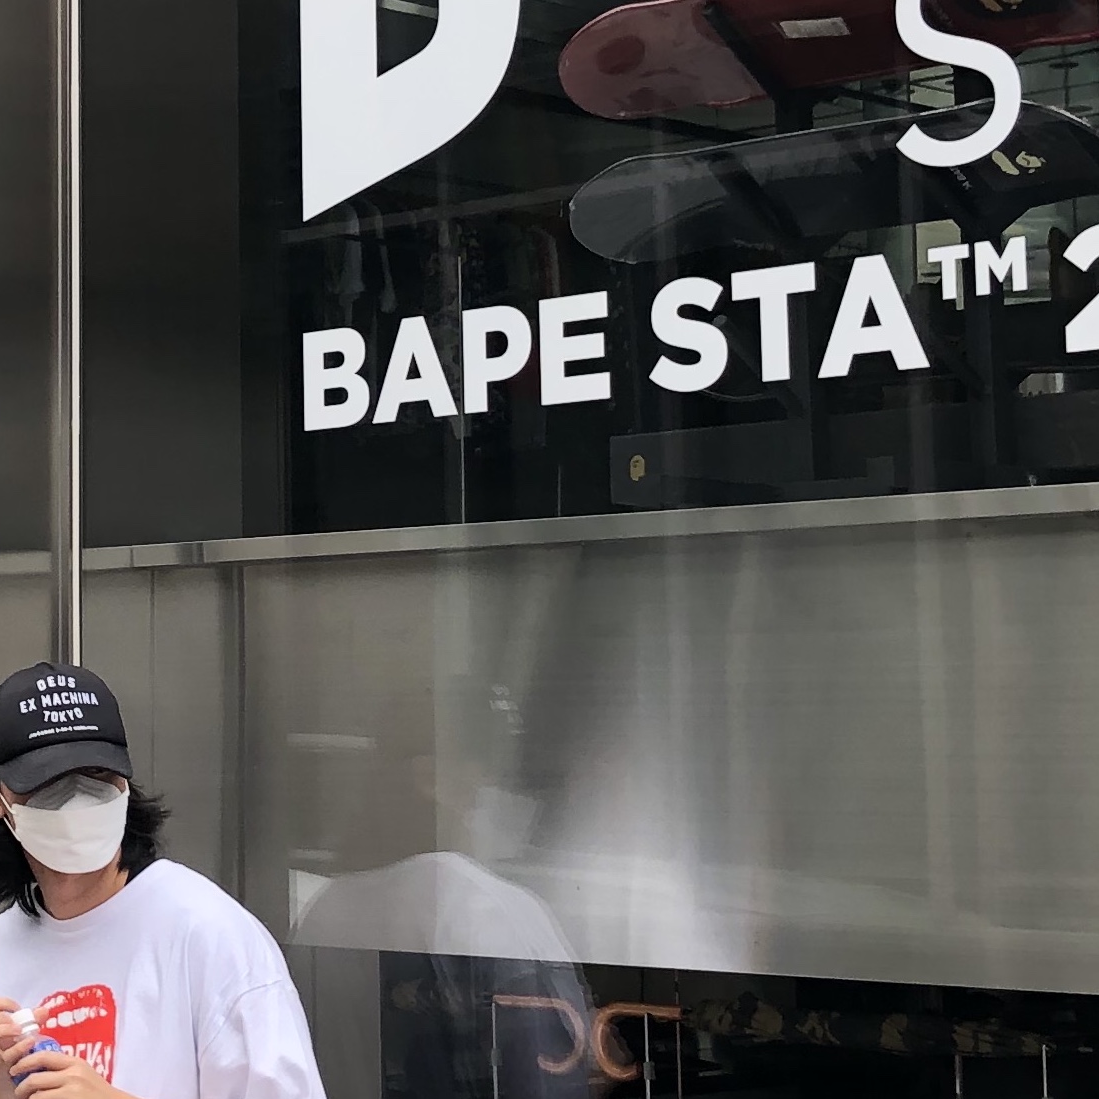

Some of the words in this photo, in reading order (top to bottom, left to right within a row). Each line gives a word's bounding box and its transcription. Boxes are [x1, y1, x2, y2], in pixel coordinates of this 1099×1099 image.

[302, 291, 612, 433] BAPE
[36, 674, 76, 692] DEUS
[19, 697, 37, 714] EX
[40, 691, 99, 708] MACHINA
[43, 706, 84, 723] TOKYO
